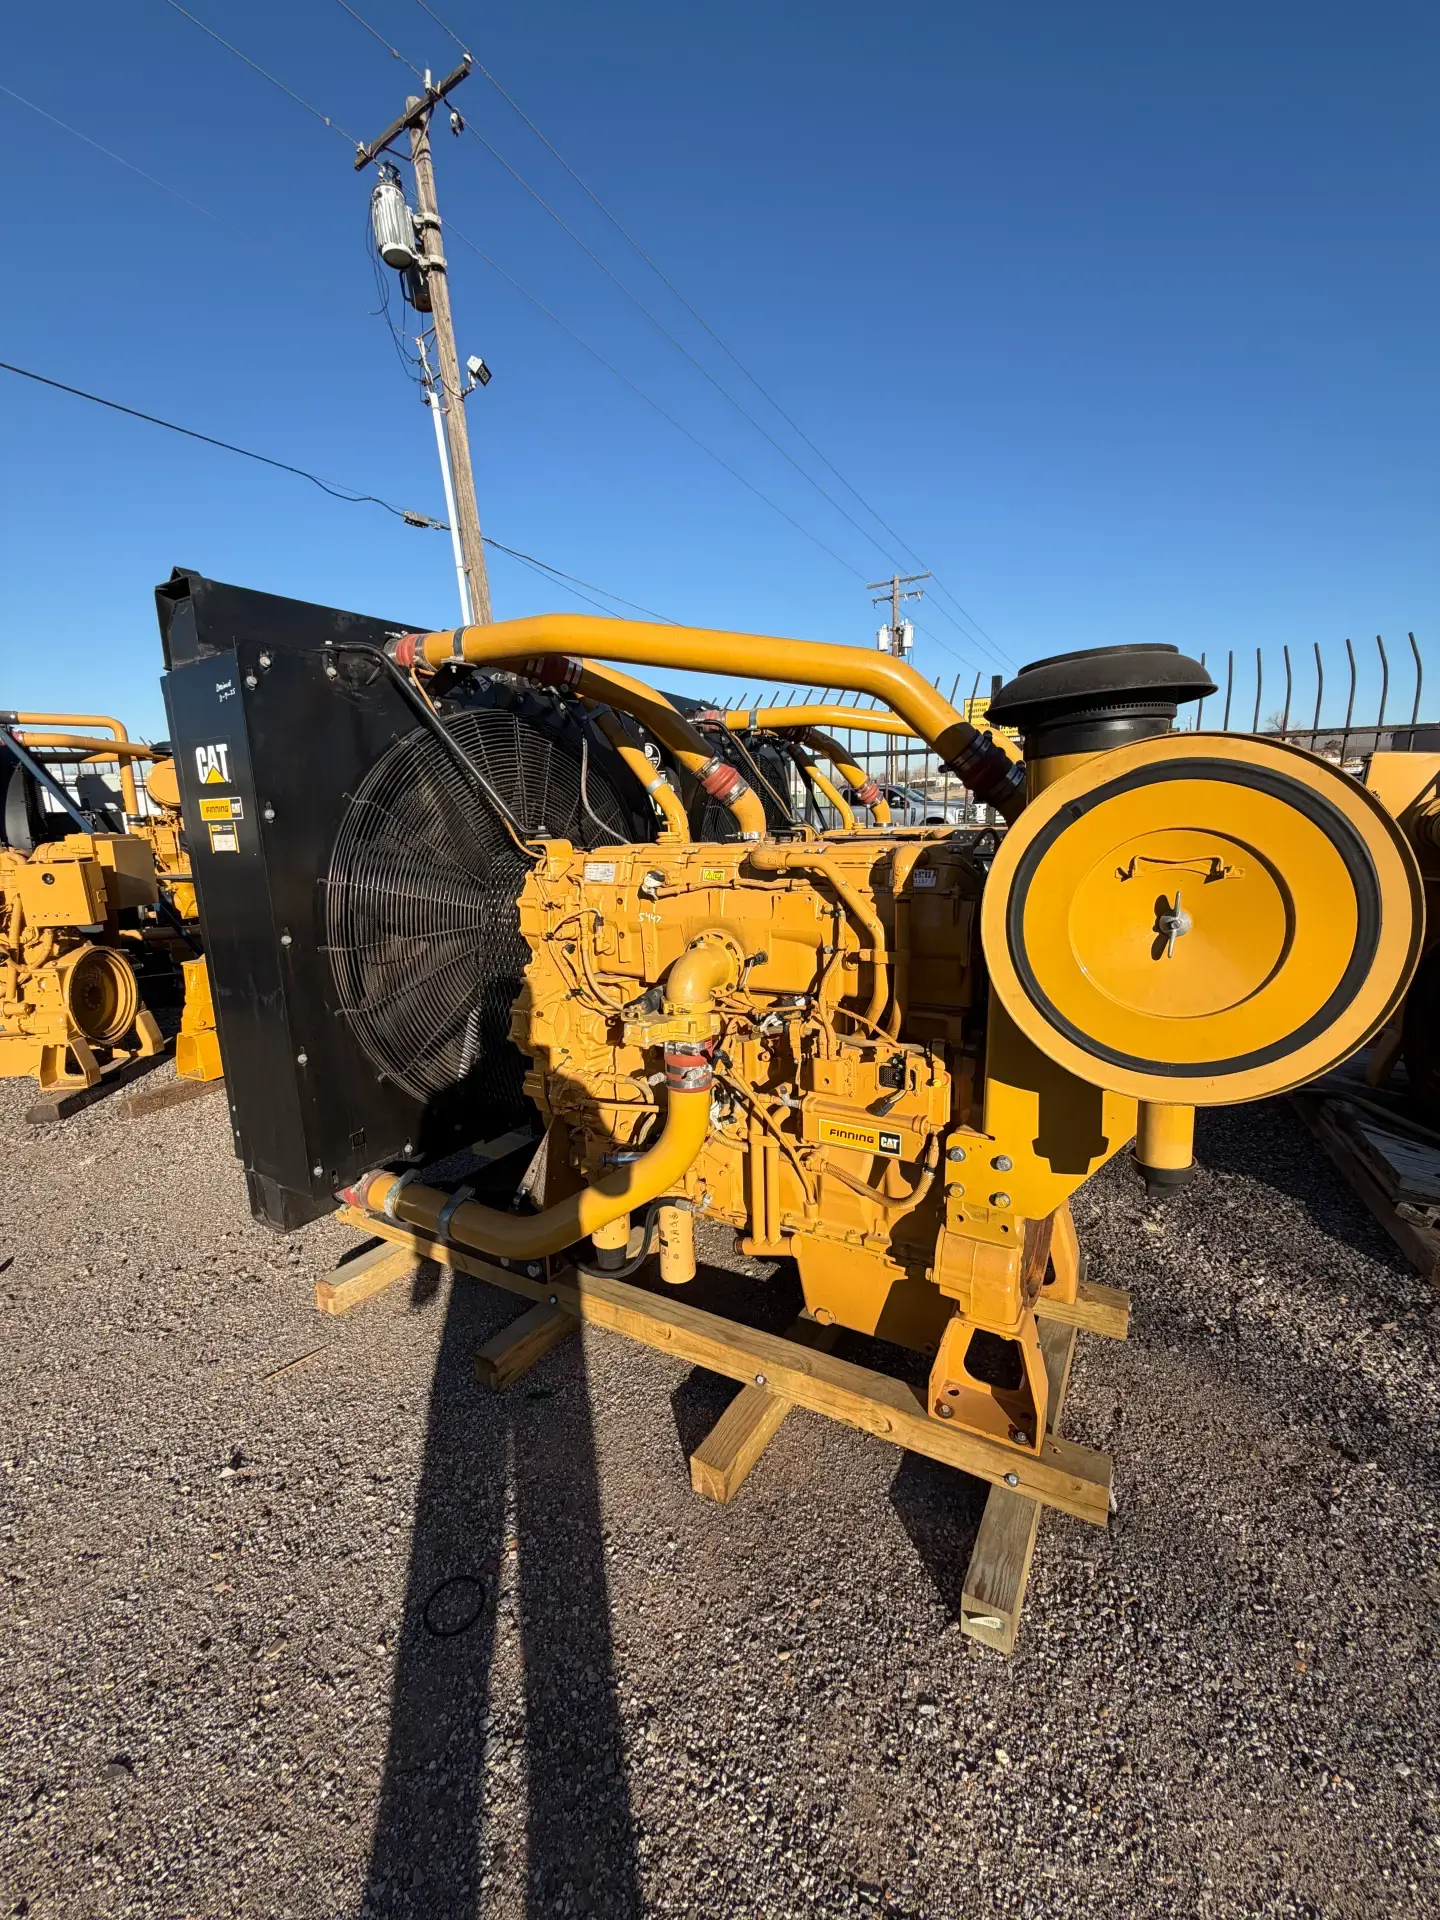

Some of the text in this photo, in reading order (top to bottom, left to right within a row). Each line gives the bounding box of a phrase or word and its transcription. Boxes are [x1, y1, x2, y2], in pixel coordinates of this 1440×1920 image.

[195, 743, 229, 785] CAT
[205, 805, 229, 814] FINNING
[829, 1128, 899, 1150] FINNING CAT
